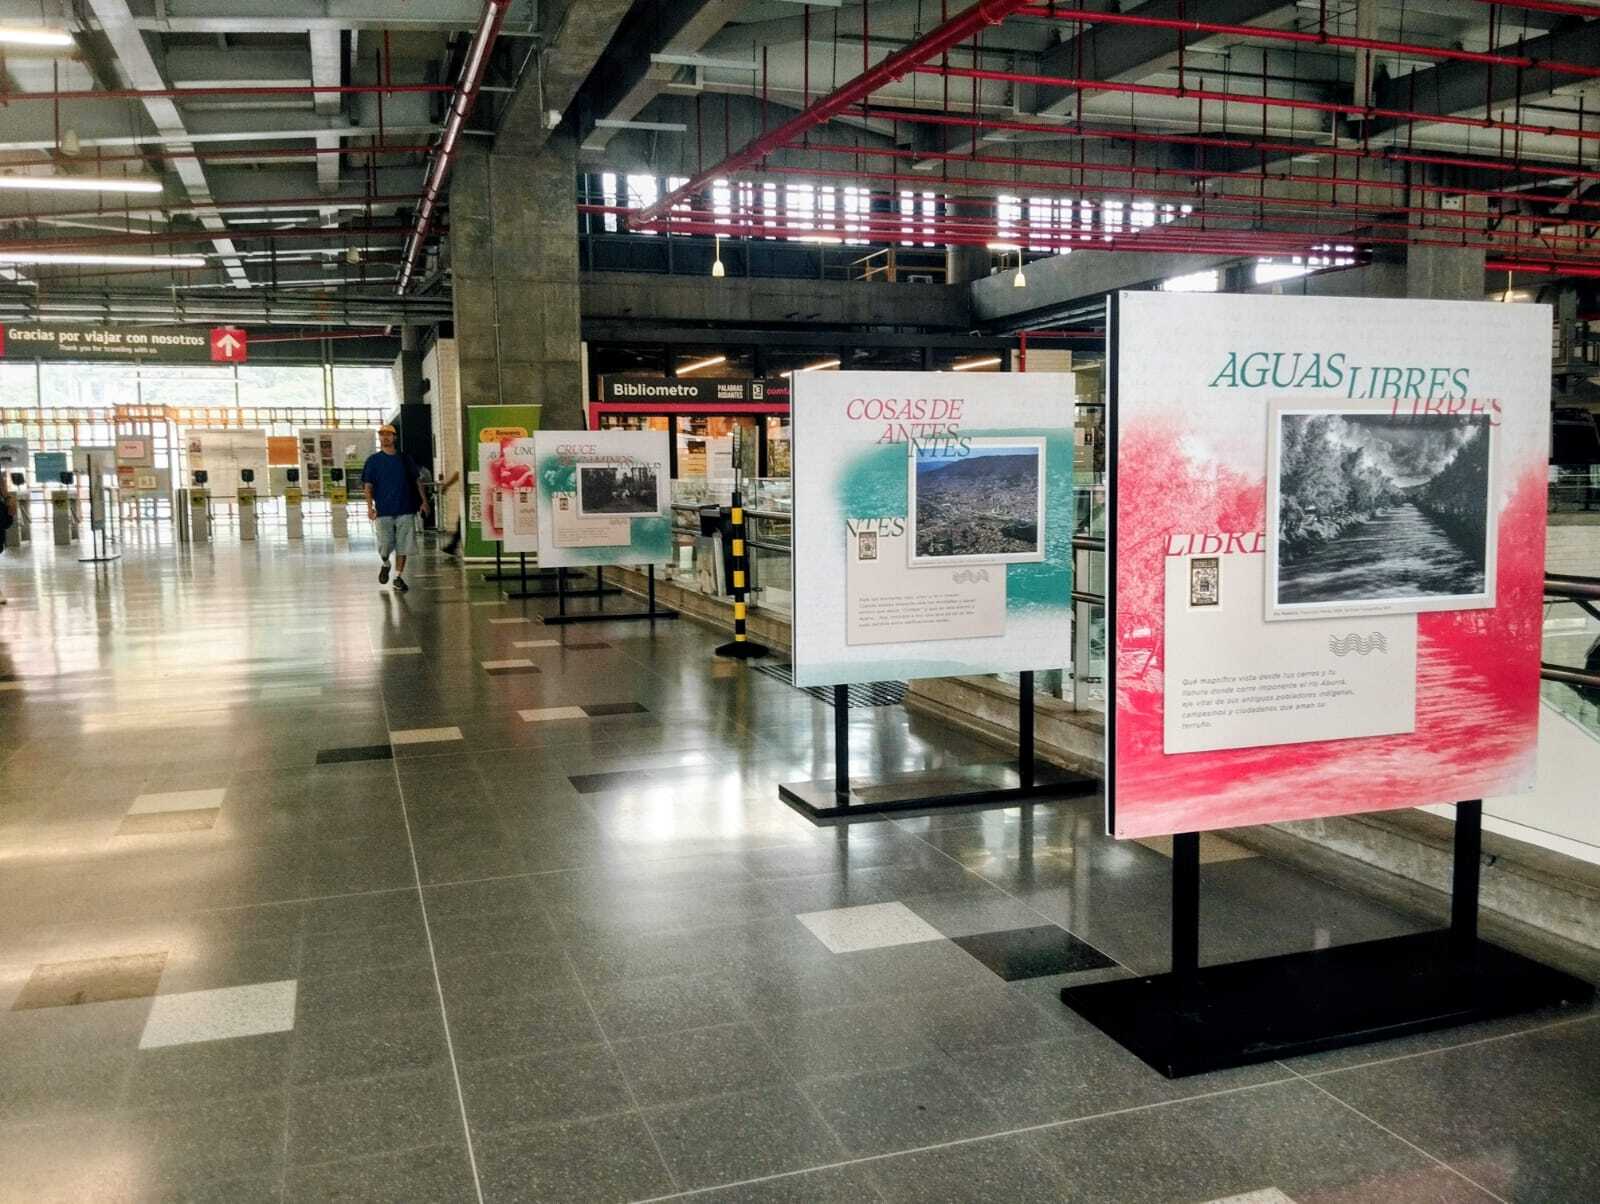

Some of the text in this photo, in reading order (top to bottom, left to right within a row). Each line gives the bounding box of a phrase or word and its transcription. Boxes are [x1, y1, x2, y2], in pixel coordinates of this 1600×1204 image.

[9, 328, 205, 345] Gracias por viajar con nosotros
[1208, 351, 1470, 400] AGUAS LIBRES
[613, 383, 699, 396] Bibliometro
[846, 398, 964, 420] COSAS DE
[875, 423, 961, 445] ANTES
